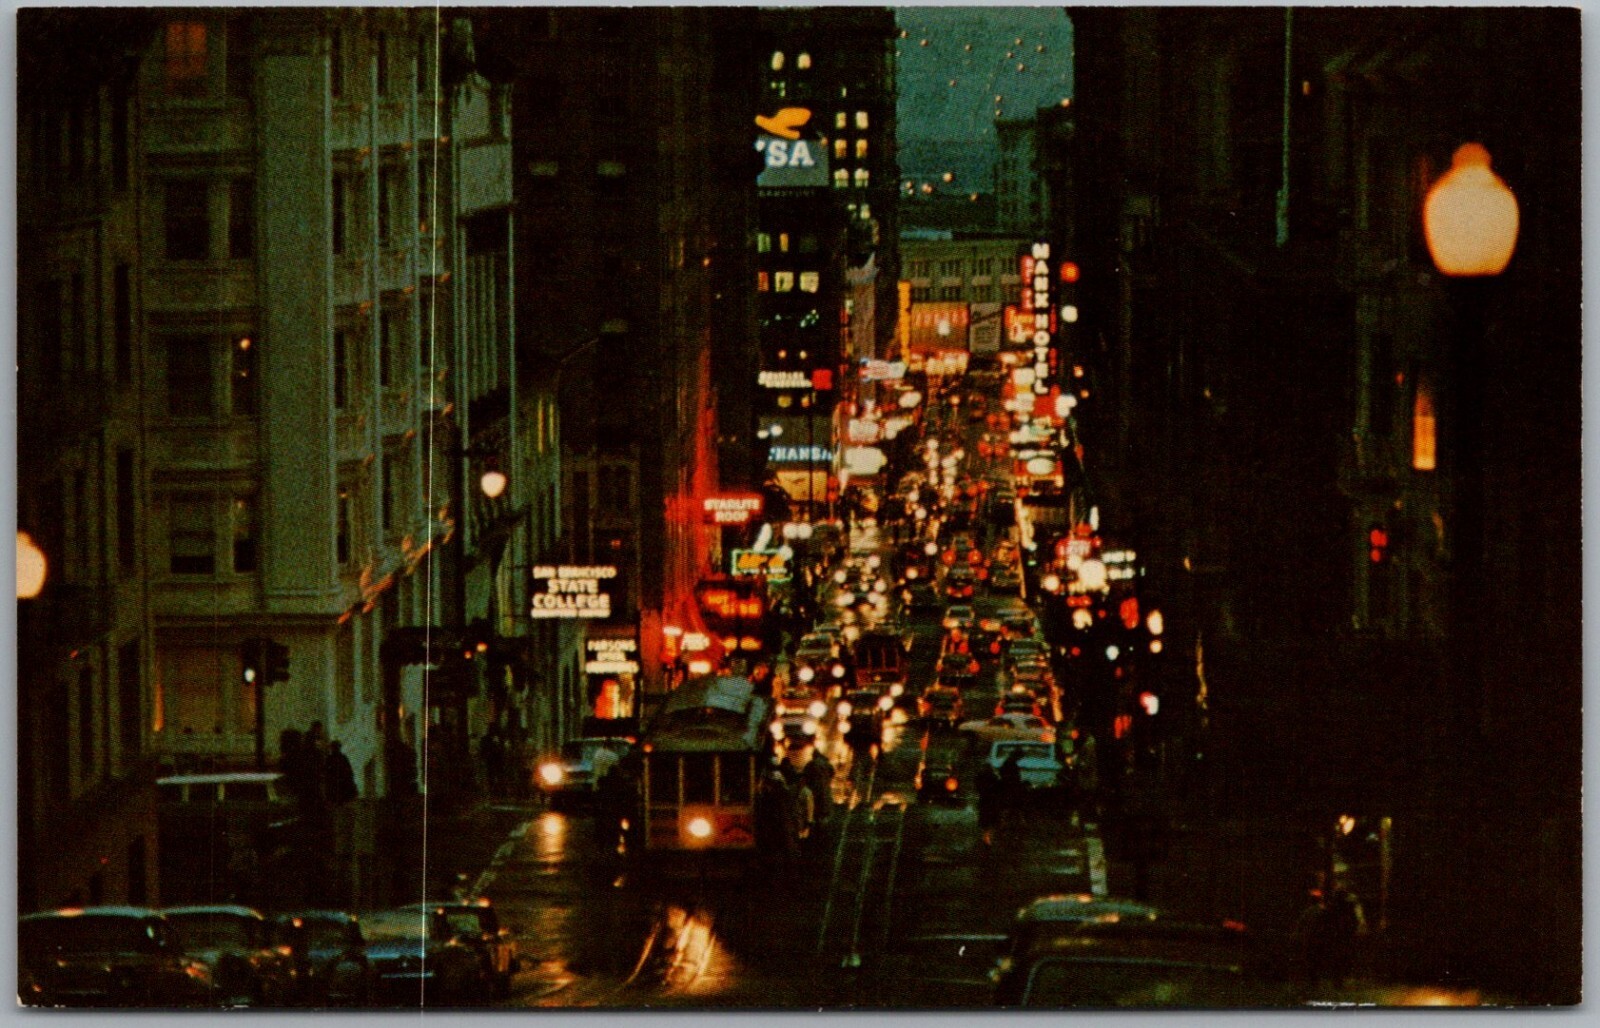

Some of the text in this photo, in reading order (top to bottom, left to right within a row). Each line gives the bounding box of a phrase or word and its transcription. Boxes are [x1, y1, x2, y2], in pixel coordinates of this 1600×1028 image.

[1032, 243, 1050, 394] MANX HOTEL
[548, 579, 598, 594] STATE
[532, 593, 610, 609] COLLEGE
